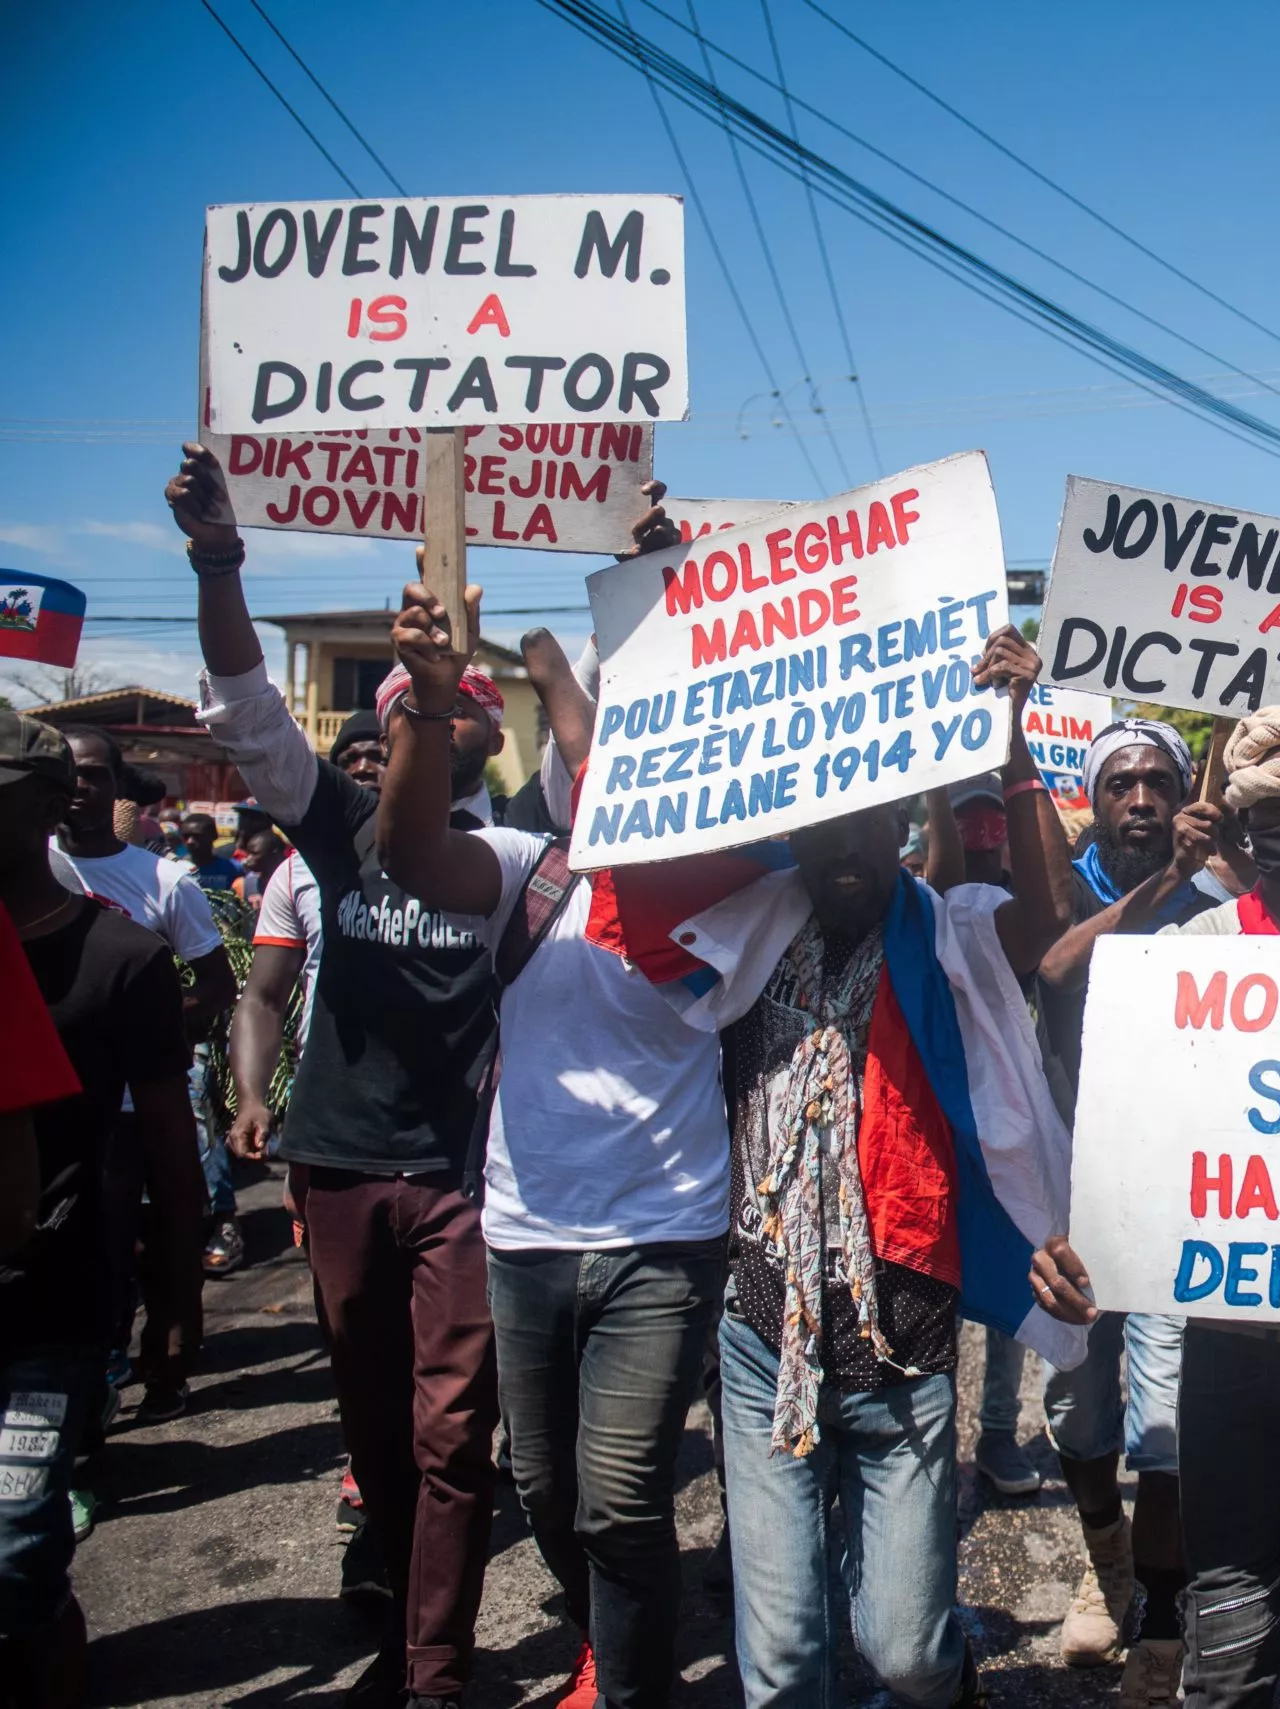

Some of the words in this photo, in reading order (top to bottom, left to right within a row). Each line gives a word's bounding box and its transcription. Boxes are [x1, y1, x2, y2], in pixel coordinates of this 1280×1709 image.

[218, 204, 537, 283] JOVENEL
[573, 209, 671, 285] M.
[347, 294, 407, 341] IS
[467, 293, 510, 338] A
[251, 352, 670, 424] DICTATOR
[228, 433, 419, 488] DIKTATI
[498, 422, 643, 463] SOUTNI
[492, 500, 558, 543] LA
[662, 488, 920, 617] MOLEGHAF
[691, 575, 860, 669] MANDE
[1171, 583, 1223, 624] IS
[598, 689, 676, 746] POU
[683, 644, 828, 727] ETAZINI
[838, 590, 998, 681] REMÈT
[606, 724, 754, 795] REZÈV
[762, 701, 815, 757] LÒ
[821, 688, 864, 741] YO
[872, 674, 915, 724] TE
[588, 790, 689, 846] NAN
[813, 729, 916, 799] 1914
[932, 708, 992, 761] YO
